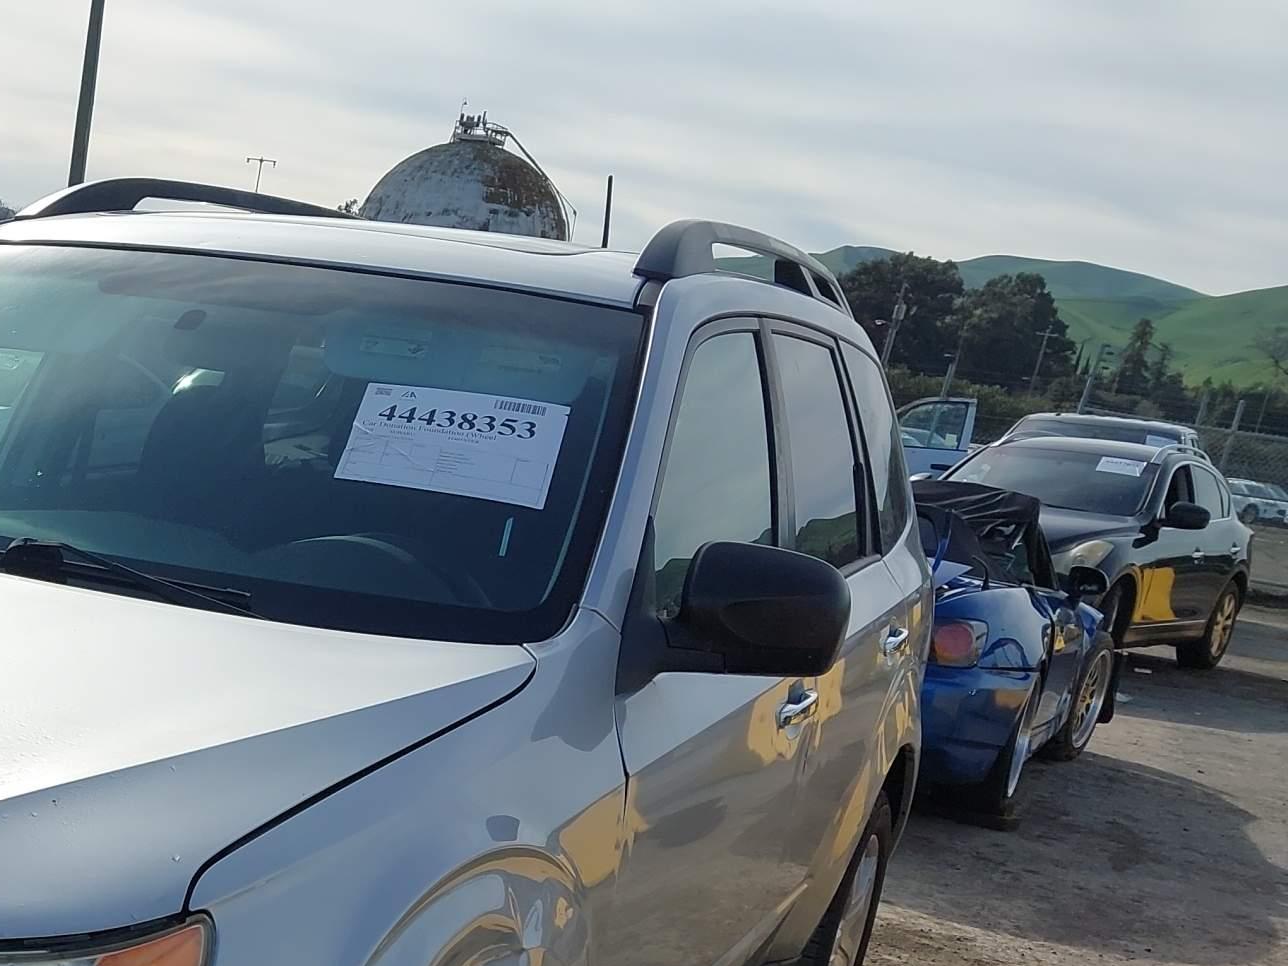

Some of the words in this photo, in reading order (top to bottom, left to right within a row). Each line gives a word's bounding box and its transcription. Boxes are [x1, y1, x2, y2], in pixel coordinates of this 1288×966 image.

[362, 419, 377, 427] Car
[379, 420, 417, 432] Donation
[418, 425, 465, 437] Foundation
[378, 404, 538, 440] 44438353
